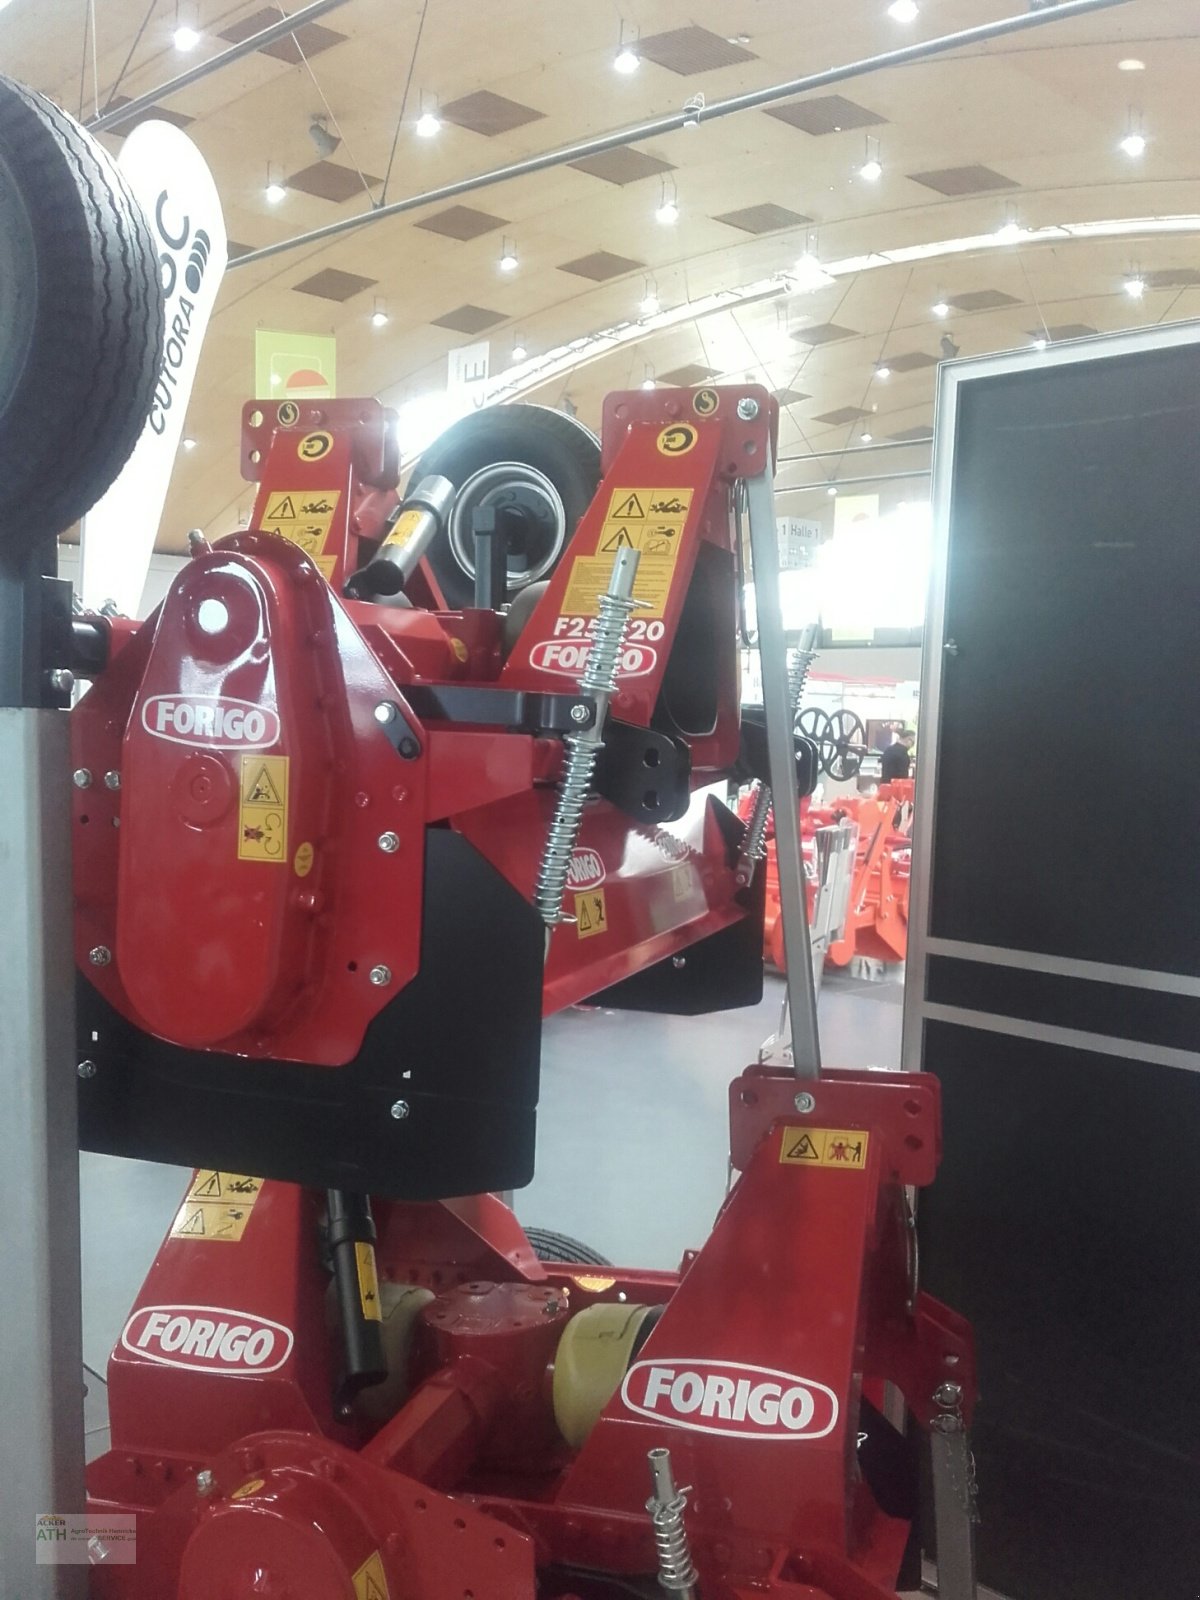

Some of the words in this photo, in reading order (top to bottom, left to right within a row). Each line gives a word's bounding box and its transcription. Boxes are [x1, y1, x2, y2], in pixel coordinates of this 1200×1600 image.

[790, 524, 813, 538] Halle
[156, 700, 266, 742] FORIGO
[136, 1312, 275, 1366] FORIGO
[643, 1367, 815, 1430] FORIGO
